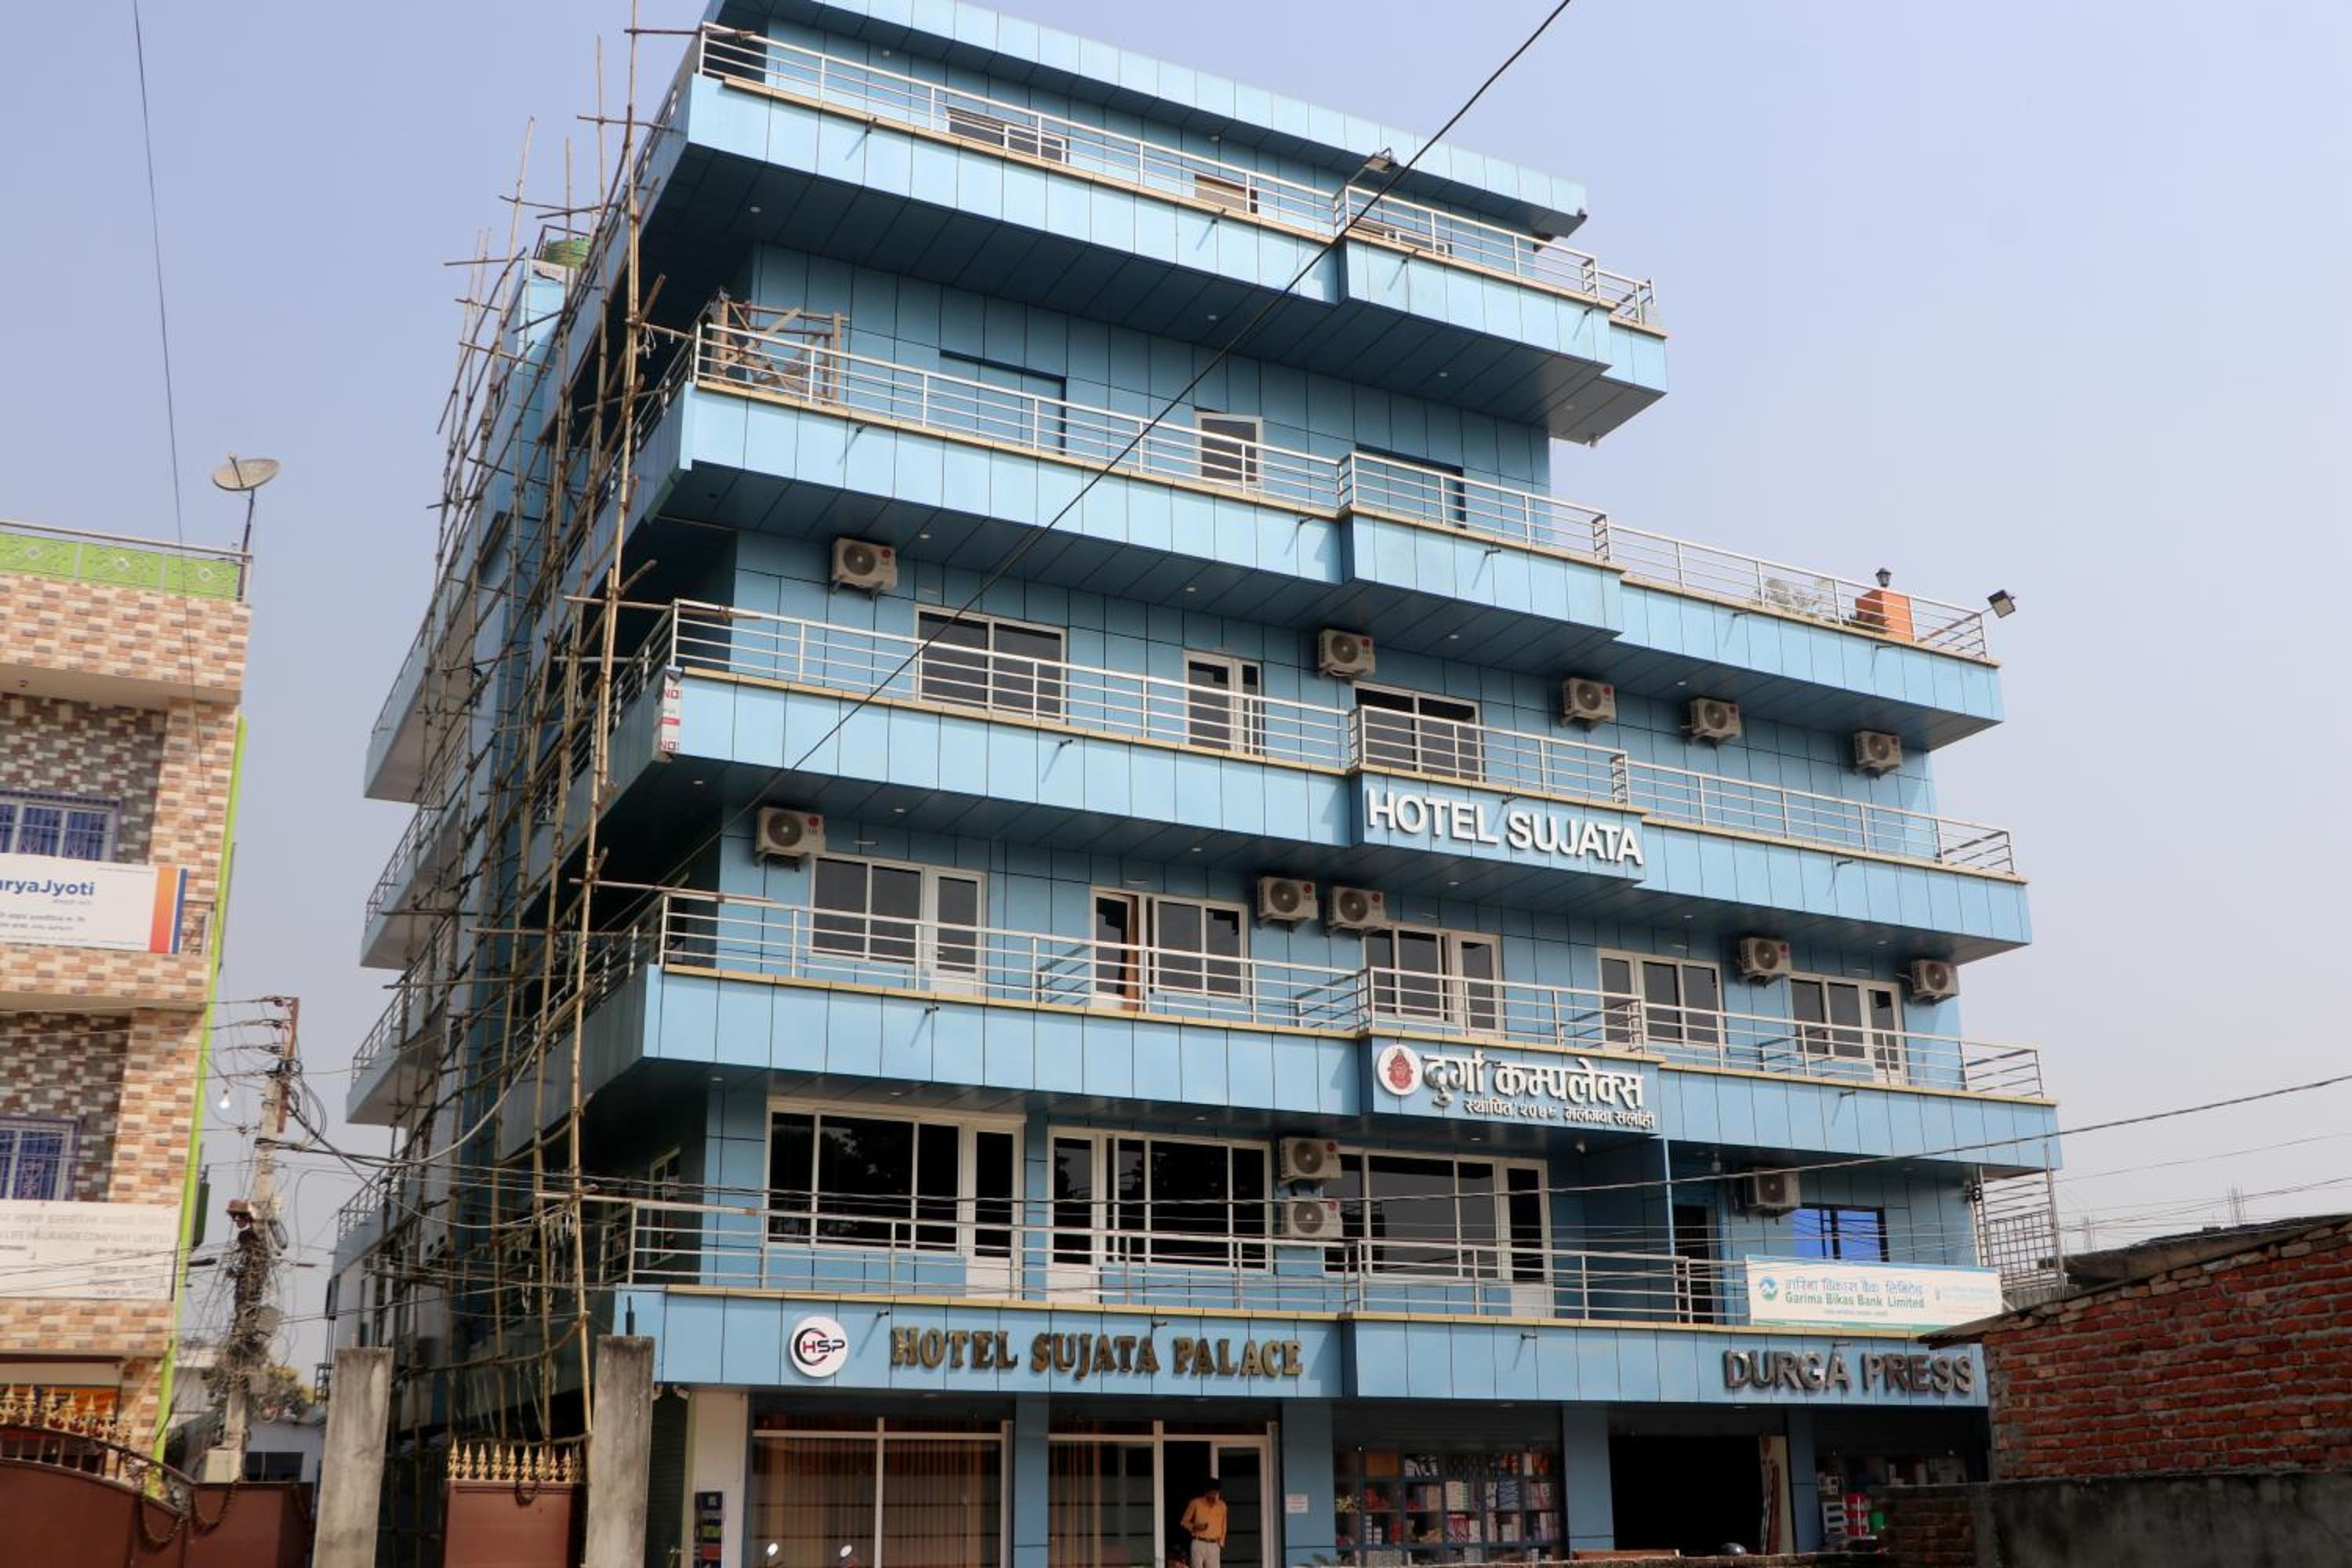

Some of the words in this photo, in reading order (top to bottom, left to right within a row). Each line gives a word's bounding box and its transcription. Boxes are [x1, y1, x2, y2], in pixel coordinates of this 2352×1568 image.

[1367, 789, 1499, 844] HOTEL
[1508, 811, 1644, 866] SUJATA
[1422, 1049, 1490, 1107] दुर्गा
[1785, 1292, 1823, 1305] Garima
[1826, 1293, 1854, 1305] Bikas
[1857, 1294, 1882, 1306] Bank
[1887, 1296, 1925, 1308] Limited
[891, 1327, 1018, 1369] HOTEL
[1029, 1332, 1160, 1381] SUJATA
[1173, 1337, 1304, 1377] PALACE
[1724, 1349, 1851, 1391] DURGA
[1862, 1353, 1973, 1392] PRESS
